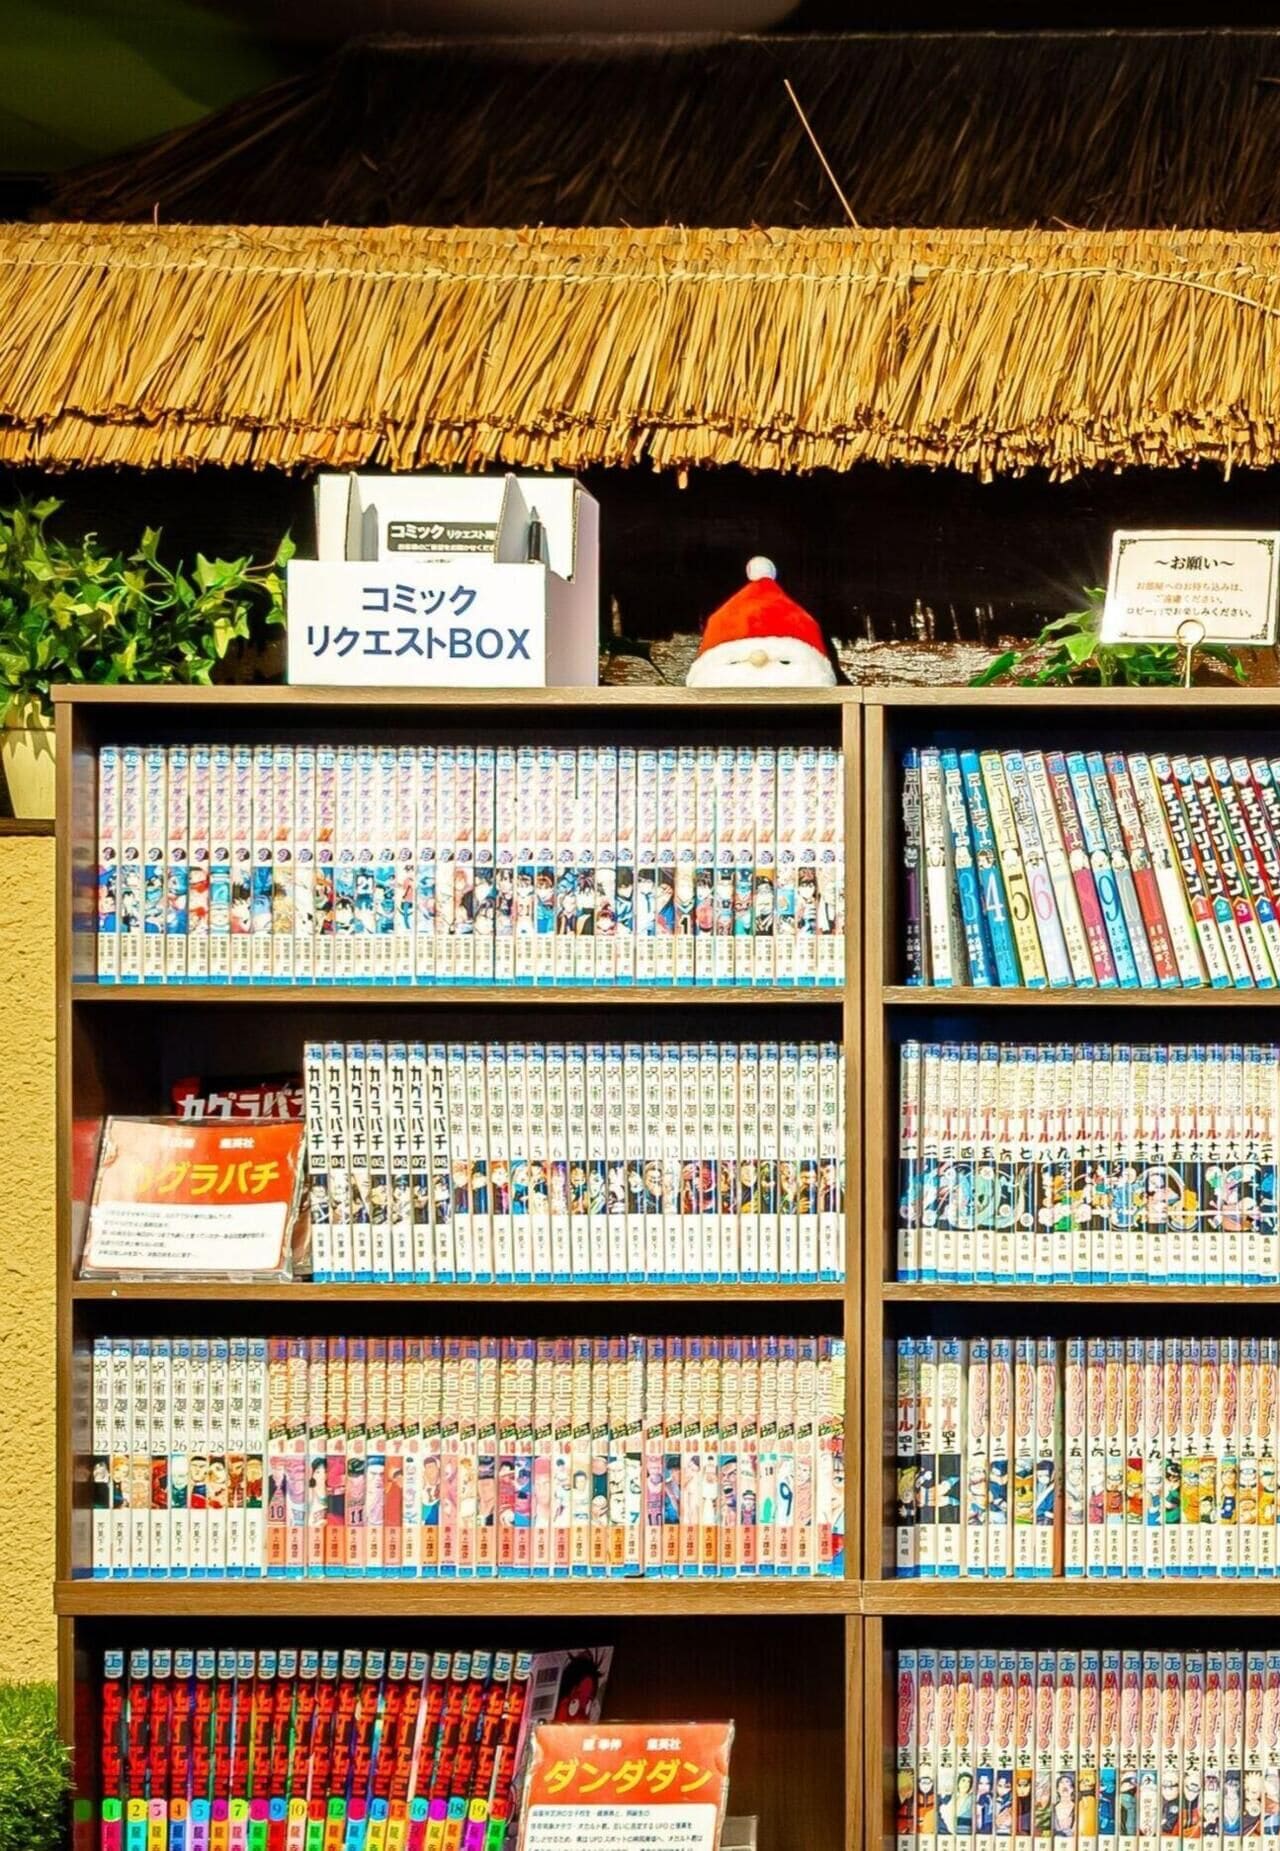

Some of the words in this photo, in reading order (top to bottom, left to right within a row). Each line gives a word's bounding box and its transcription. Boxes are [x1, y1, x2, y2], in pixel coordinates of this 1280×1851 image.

[390, 524, 445, 539] コミック
[362, 584, 477, 616] コミック
[307, 626, 530, 659] リクエストBOX
[959, 872, 978, 921] 3
[986, 871, 1005, 922] 4
[1008, 873, 1030, 921] 5
[1032, 874, 1053, 921] 6
[1098, 874, 1119, 921] 9
[308, 1065, 325, 1150] カグラバチ
[328, 1066, 345, 1150] カグラバチ
[350, 1065, 366, 1149] カグラバチ
[369, 1066, 384, 1150] カグラバチ
[392, 1066, 408, 1150] カグラバチ
[410, 1065, 426, 1150] カグラバチ
[543, 1756, 713, 1794] ダンダダン
